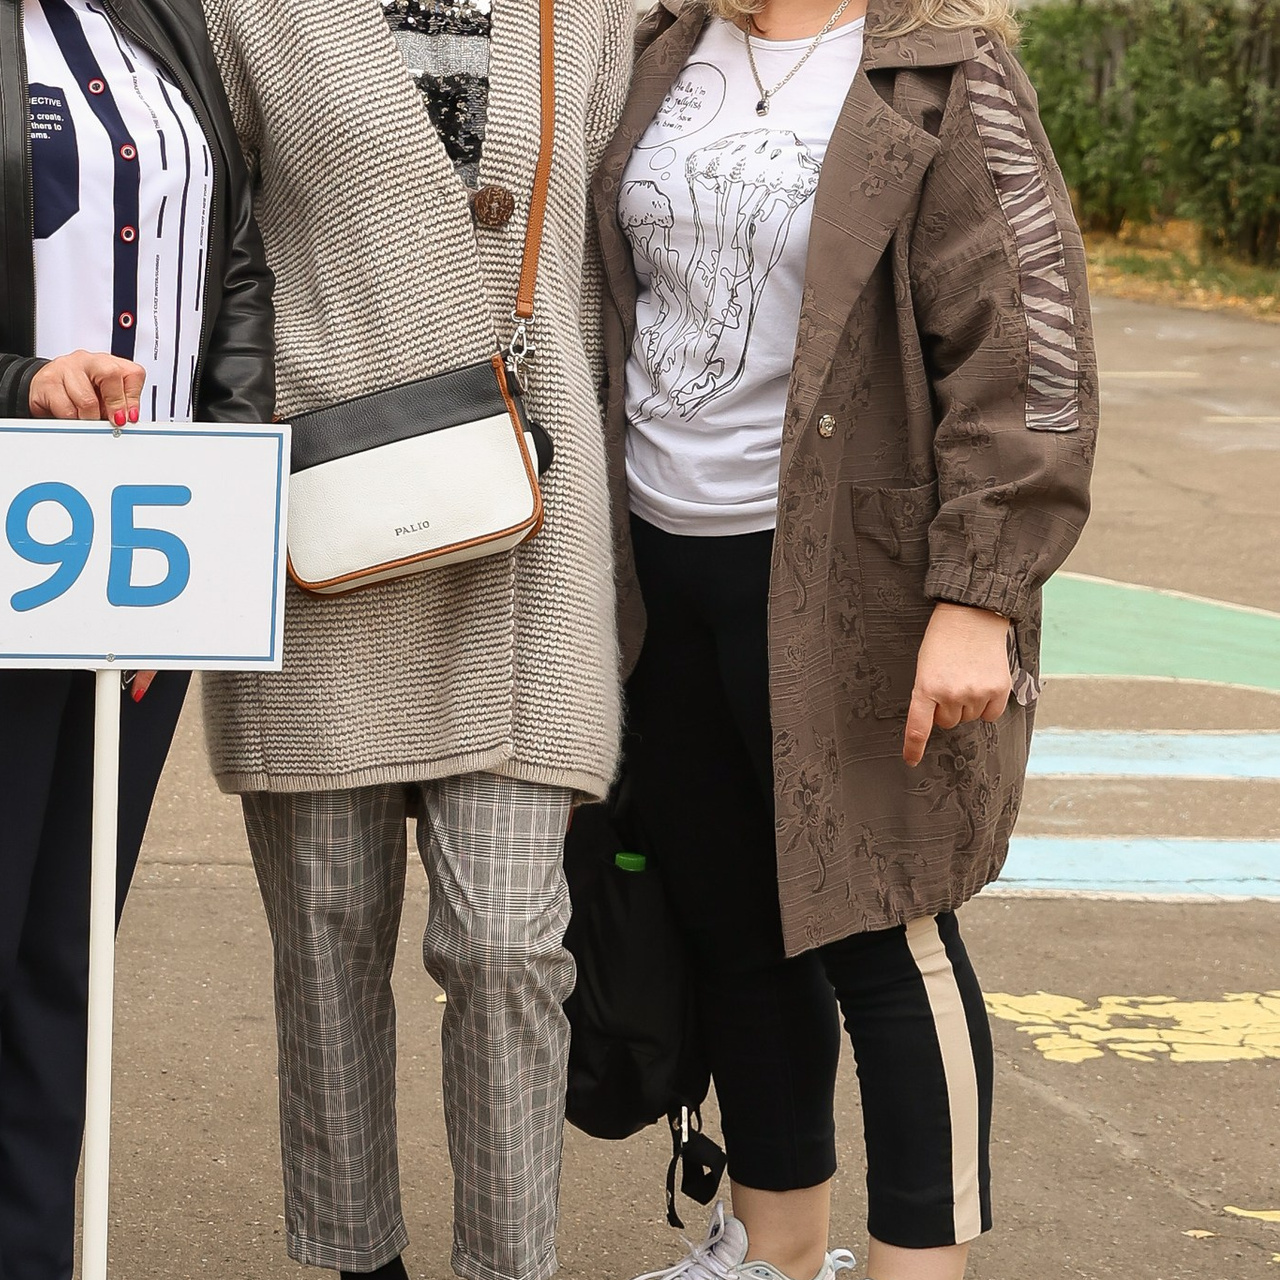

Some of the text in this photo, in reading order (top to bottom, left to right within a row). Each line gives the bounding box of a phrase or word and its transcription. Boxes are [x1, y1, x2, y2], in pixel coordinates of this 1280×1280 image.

[31, 122, 53, 130] thers
[394, 520, 430, 537] PALIO
[5, 481, 192, 613] 9Б
